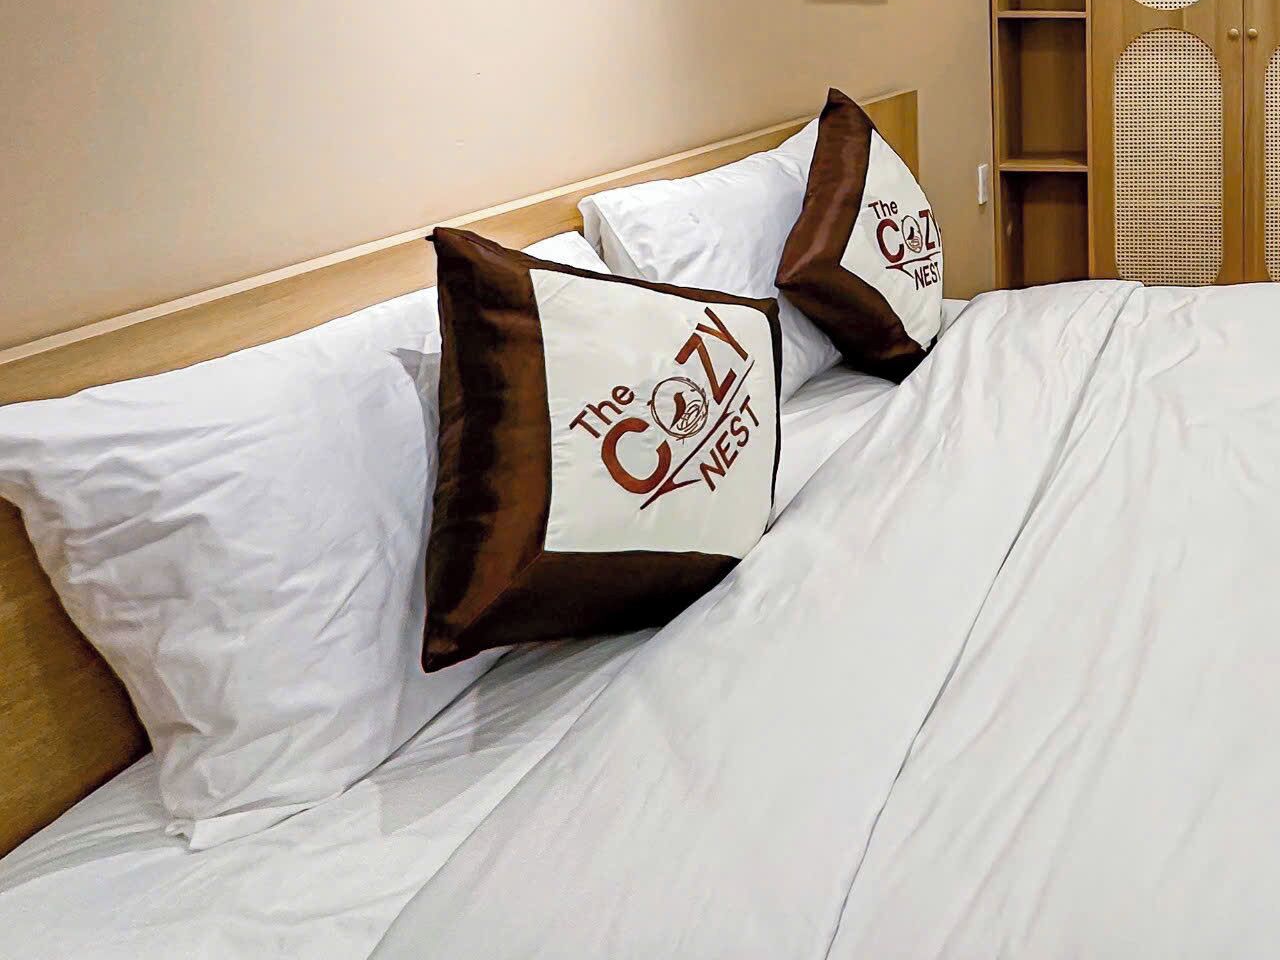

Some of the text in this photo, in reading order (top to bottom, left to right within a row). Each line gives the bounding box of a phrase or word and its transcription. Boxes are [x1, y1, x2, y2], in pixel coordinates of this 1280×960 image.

[868, 200, 898, 219] The
[569, 385, 635, 439] The
[601, 307, 748, 494] COZY
[699, 396, 760, 491] NEST
